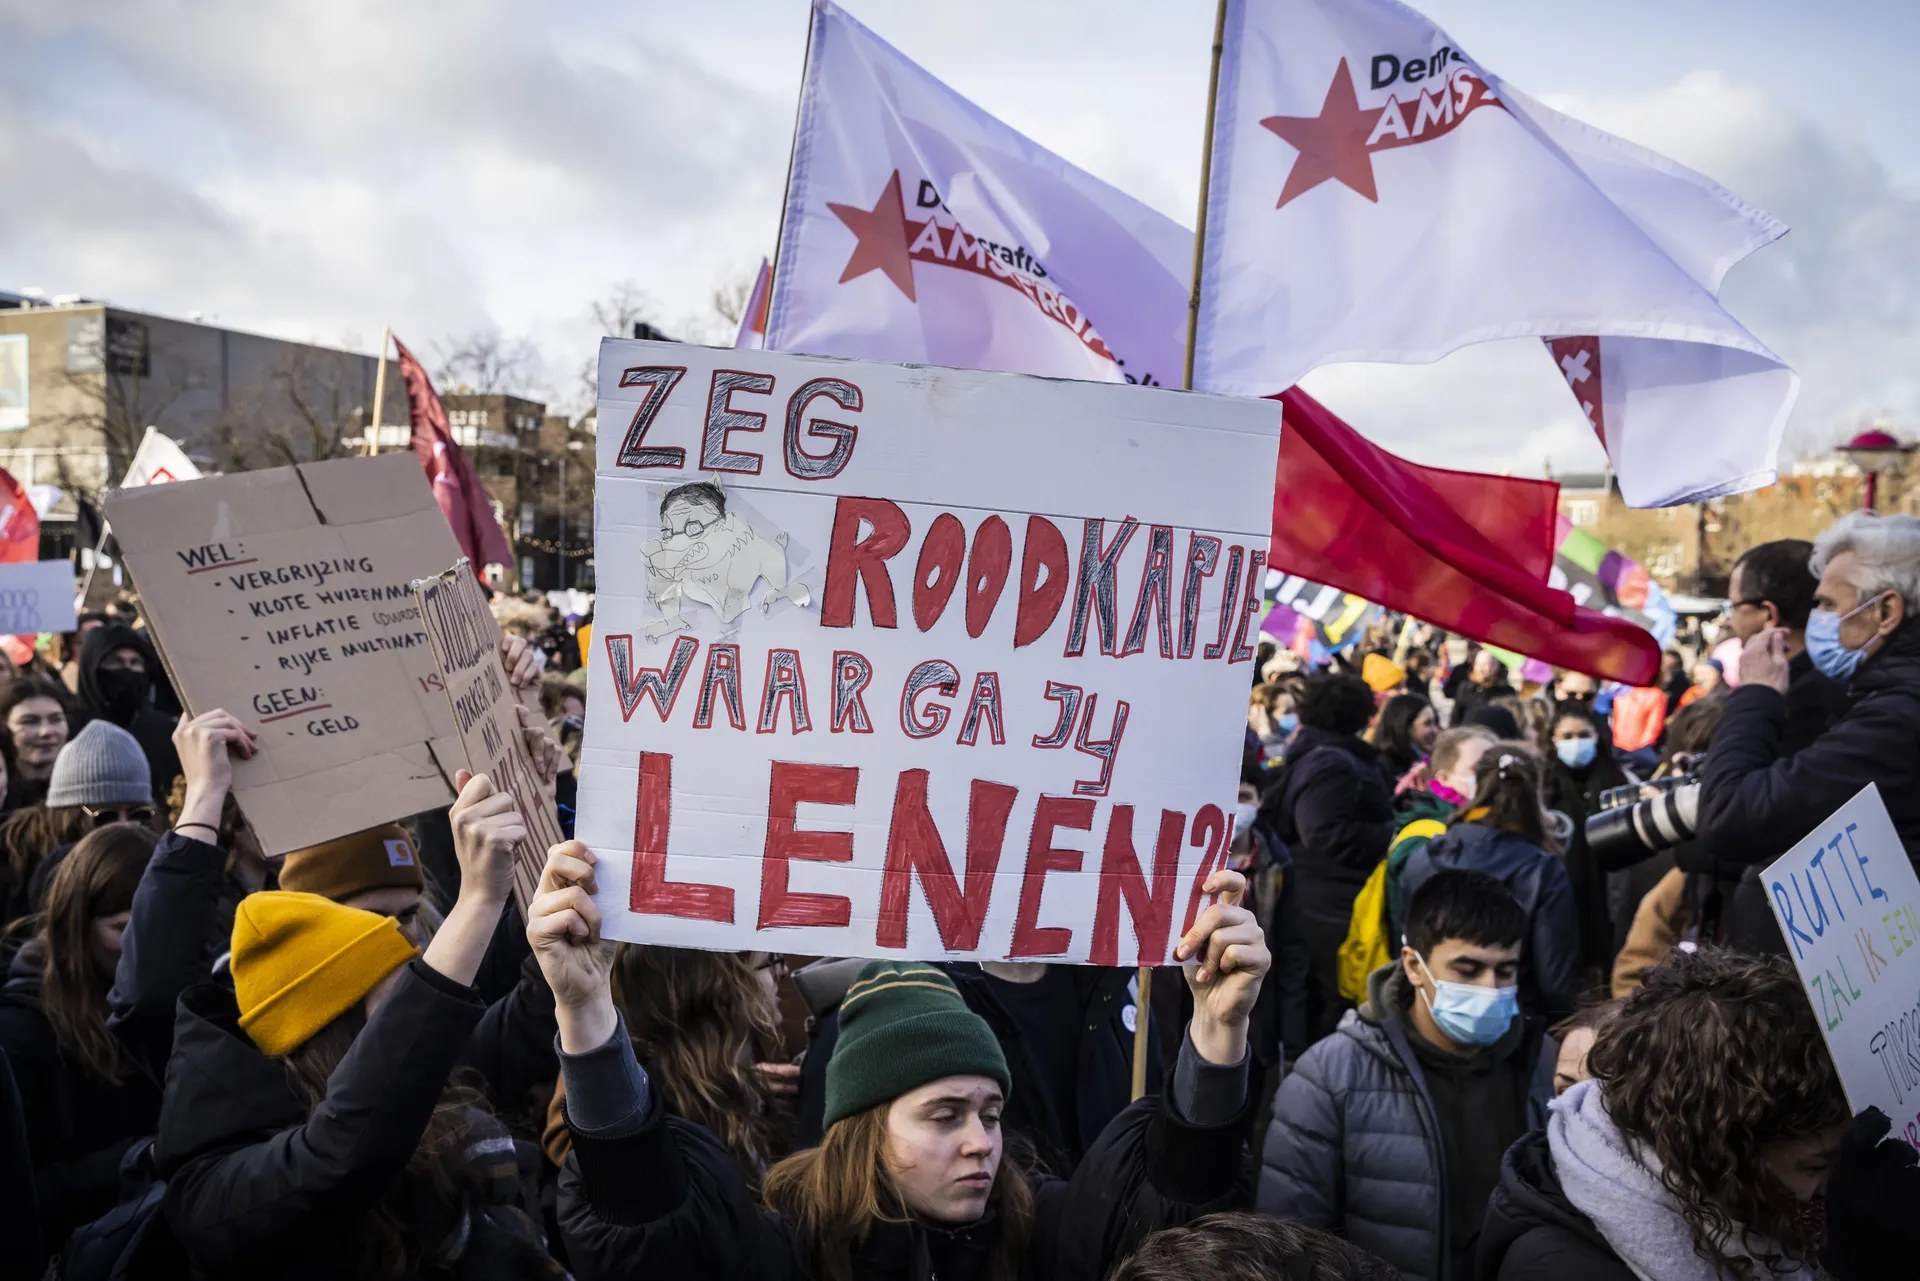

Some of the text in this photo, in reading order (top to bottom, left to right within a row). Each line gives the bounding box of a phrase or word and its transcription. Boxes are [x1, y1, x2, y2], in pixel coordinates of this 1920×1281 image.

[615, 365, 864, 481] ZEG
[177, 543, 245, 568] WEL:
[249, 583, 415, 617] KLOTE HUIZENMA
[820, 495, 1267, 665] ROODKAPJE
[266, 615, 361, 645] INFLATIE
[278, 648, 332, 676] RIJKE
[253, 687, 325, 715] GEEN:
[455, 674, 491, 735] DIKKER
[604, 633, 873, 735] WAAR
[899, 658, 1006, 747] GA
[307, 715, 359, 737] GELD
[1771, 822, 1889, 961] RUTTE,
[1810, 954, 1862, 1032] ZAL
[1854, 927, 1888, 984] IK
